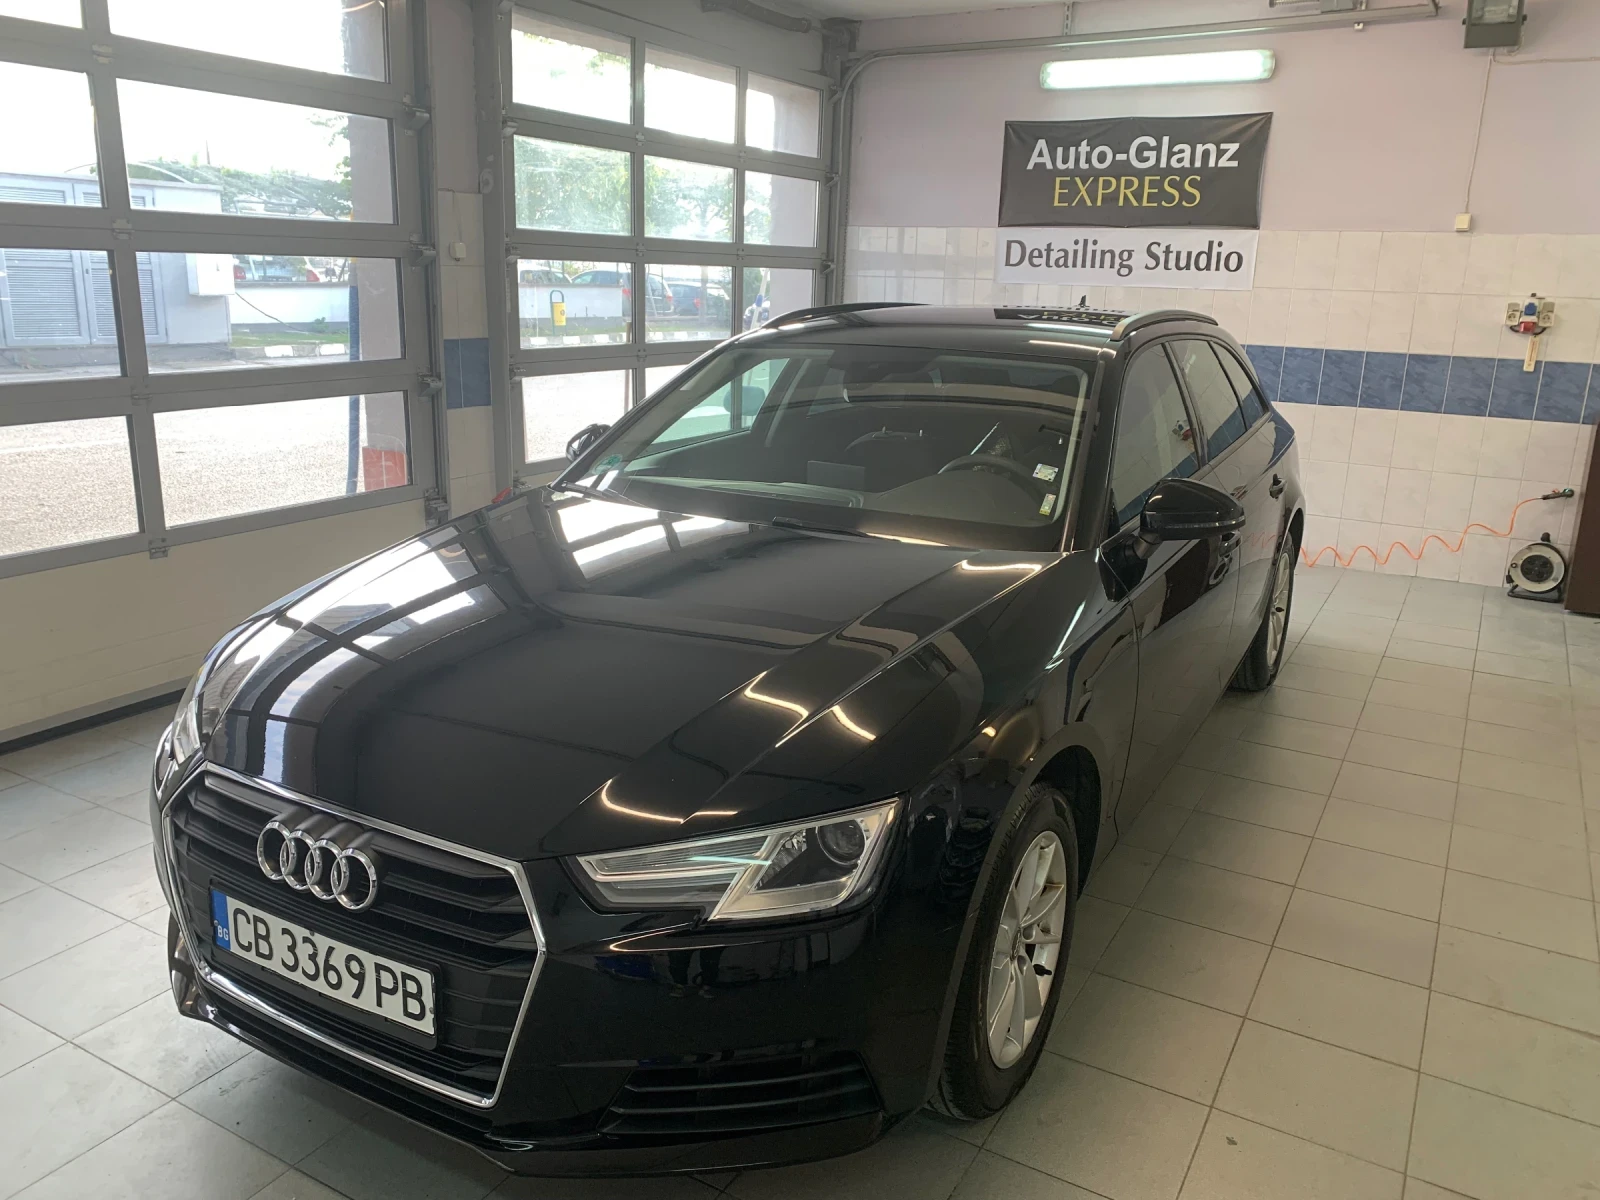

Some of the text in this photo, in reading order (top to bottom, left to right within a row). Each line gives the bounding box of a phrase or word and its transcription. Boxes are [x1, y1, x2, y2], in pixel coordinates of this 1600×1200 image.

[1026, 135, 1240, 170] Auto-Glanz
[1053, 175, 1201, 207] EXPRESS
[1004, 238, 1244, 277] Detailing Studio
[217, 924, 229, 941] BG
[233, 907, 426, 1022] CB 3369 PB
